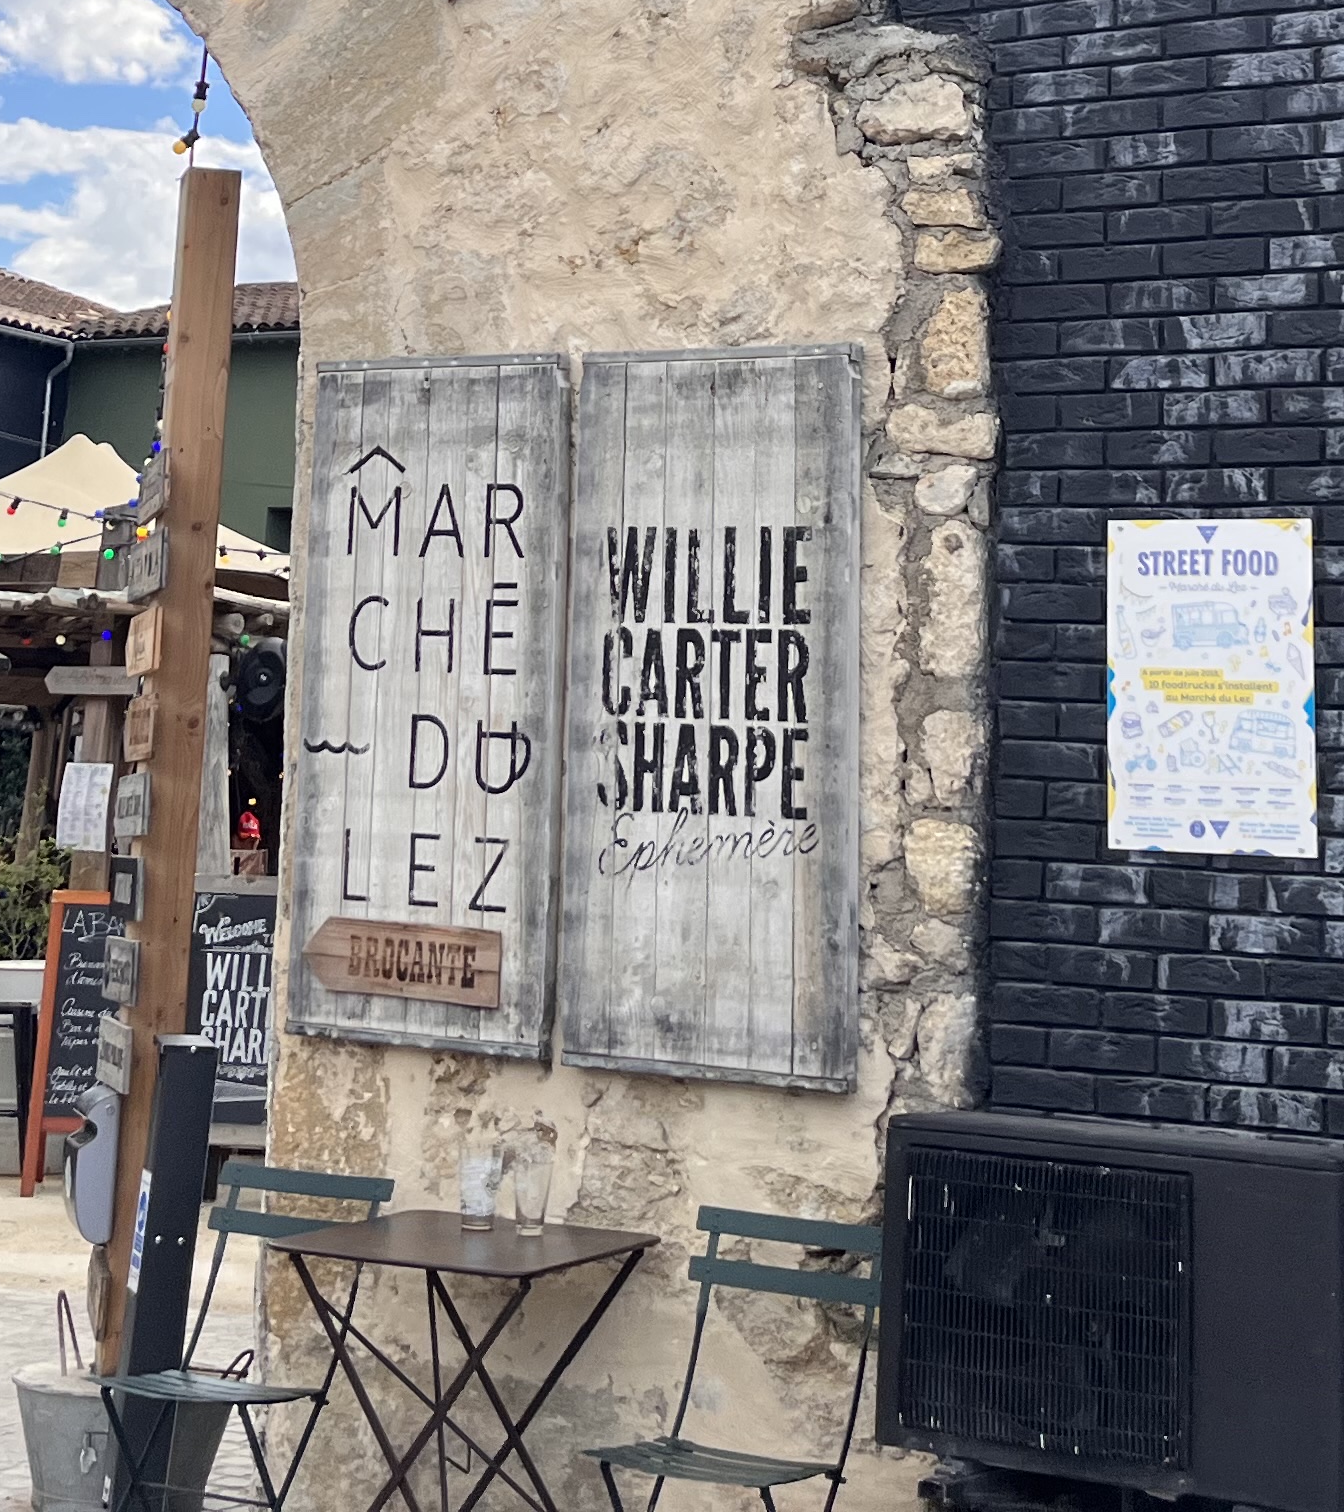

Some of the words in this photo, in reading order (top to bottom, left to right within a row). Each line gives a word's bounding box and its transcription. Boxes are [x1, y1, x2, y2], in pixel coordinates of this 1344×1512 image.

[346, 445, 525, 559] MAR
[606, 526, 812, 625] WILLIE
[1137, 549, 1213, 576] STREET
[1222, 549, 1279, 576] FOOD
[601, 628, 811, 723] CARTER
[1149, 680, 1160, 689] 10
[1161, 680, 1215, 690] foodtrucks
[1217, 681, 1273, 691] s'installent
[1181, 693, 1216, 703] Marché
[1219, 694, 1232, 703] du
[1234, 695, 1251, 703] Lez
[408, 714, 532, 795] DU
[596, 724, 810, 820] SHARPE
[341, 828, 511, 914] LEZ
[199, 916, 267, 945] WELCOME
[206, 952, 271, 992] WILL
[348, 934, 477, 989] BROCANTE
[201, 989, 272, 1029] CART
